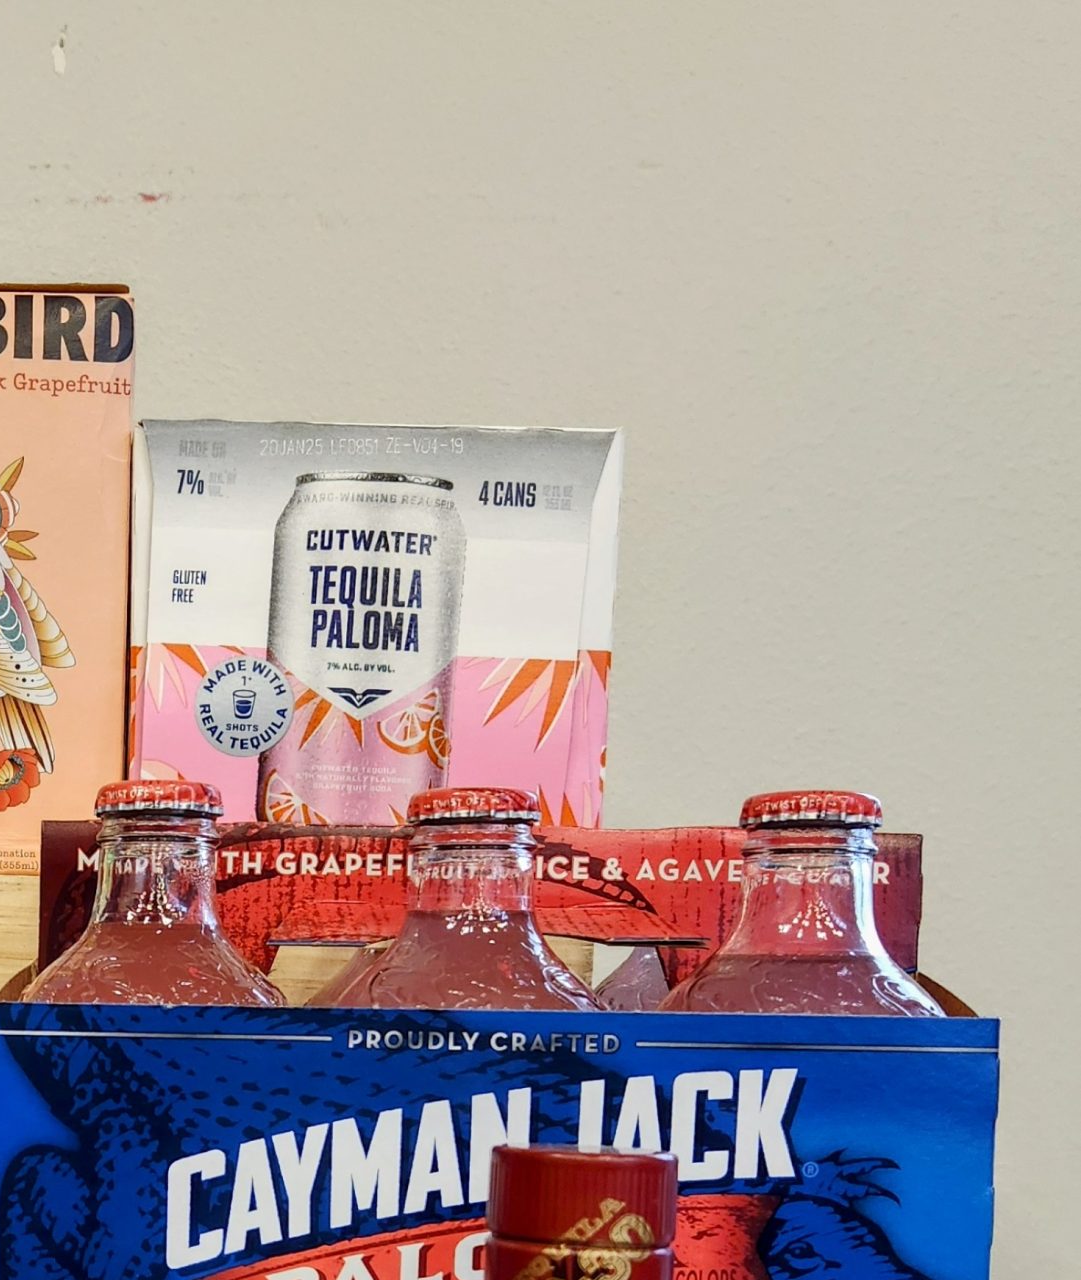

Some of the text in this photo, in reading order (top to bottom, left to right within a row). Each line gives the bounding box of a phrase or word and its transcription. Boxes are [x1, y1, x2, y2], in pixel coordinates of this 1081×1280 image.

[13, 372, 131, 398] Grapefruit
[260, 439, 323, 457] 20JAN25
[177, 469, 204, 495] 7%
[478, 481, 489, 505] 4
[494, 481, 537, 507] CANS
[307, 530, 432, 556] CUTWATER
[173, 569, 207, 585] GLUTEN
[310, 564, 422, 610] TEQUILA
[171, 588, 194, 603] FREE
[311, 608, 419, 652] PALOMA
[203, 660, 287, 696] MADE WITH
[199, 703, 288, 750] REAL TEQUILA
[225, 723, 259, 732] SHOTS
[0, 860, 40, 872] (355ml)
[348, 1030, 620, 1053] PROUDLY CRAFTED
[166, 1068, 798, 1269] CAYMAN JACK
